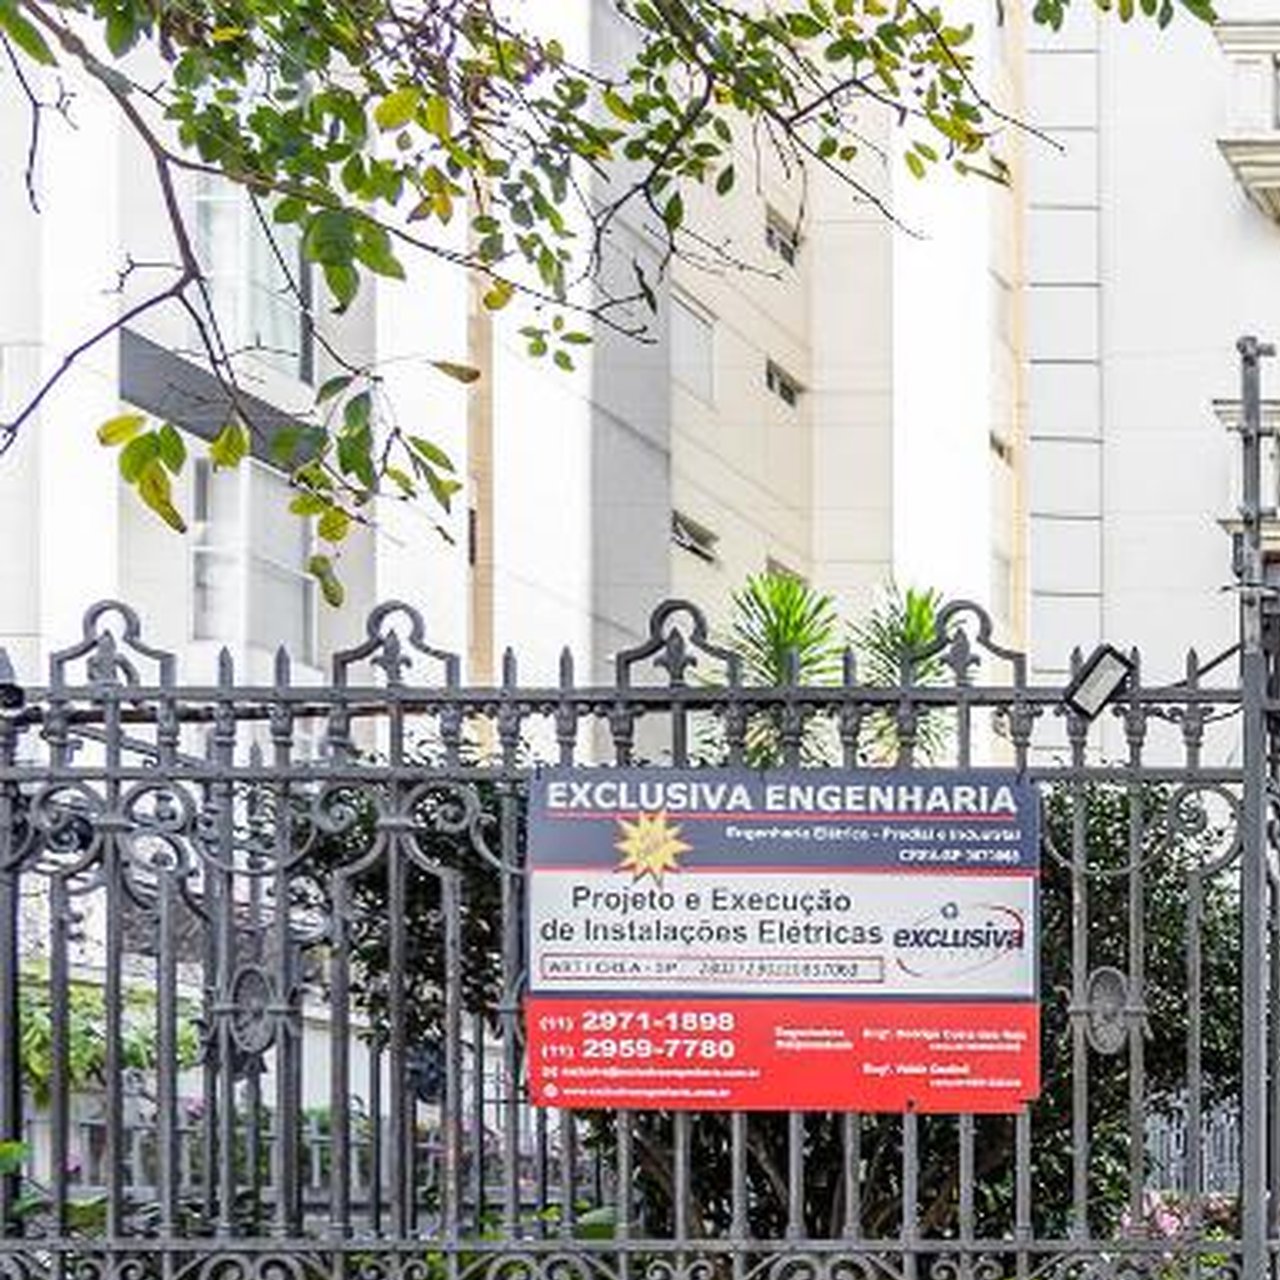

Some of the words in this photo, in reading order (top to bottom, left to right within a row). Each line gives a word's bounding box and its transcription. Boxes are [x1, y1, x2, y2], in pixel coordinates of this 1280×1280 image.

[547, 782, 752, 810] EXCLUSIVA
[765, 784, 1018, 813] ENGENHARIA
[571, 886, 675, 914] Projeto
[685, 896, 700, 911] e
[712, 886, 852, 914] Execução
[539, 919, 575, 942] de
[585, 919, 748, 945] Instalações
[757, 920, 885, 945] Elétricas
[893, 921, 1024, 949] exclusiva
[539, 1016, 574, 1032] (11)
[582, 1011, 735, 1032] 2971-1898
[541, 1044, 574, 1059] (11)
[582, 1039, 735, 1059] 2959-7780
